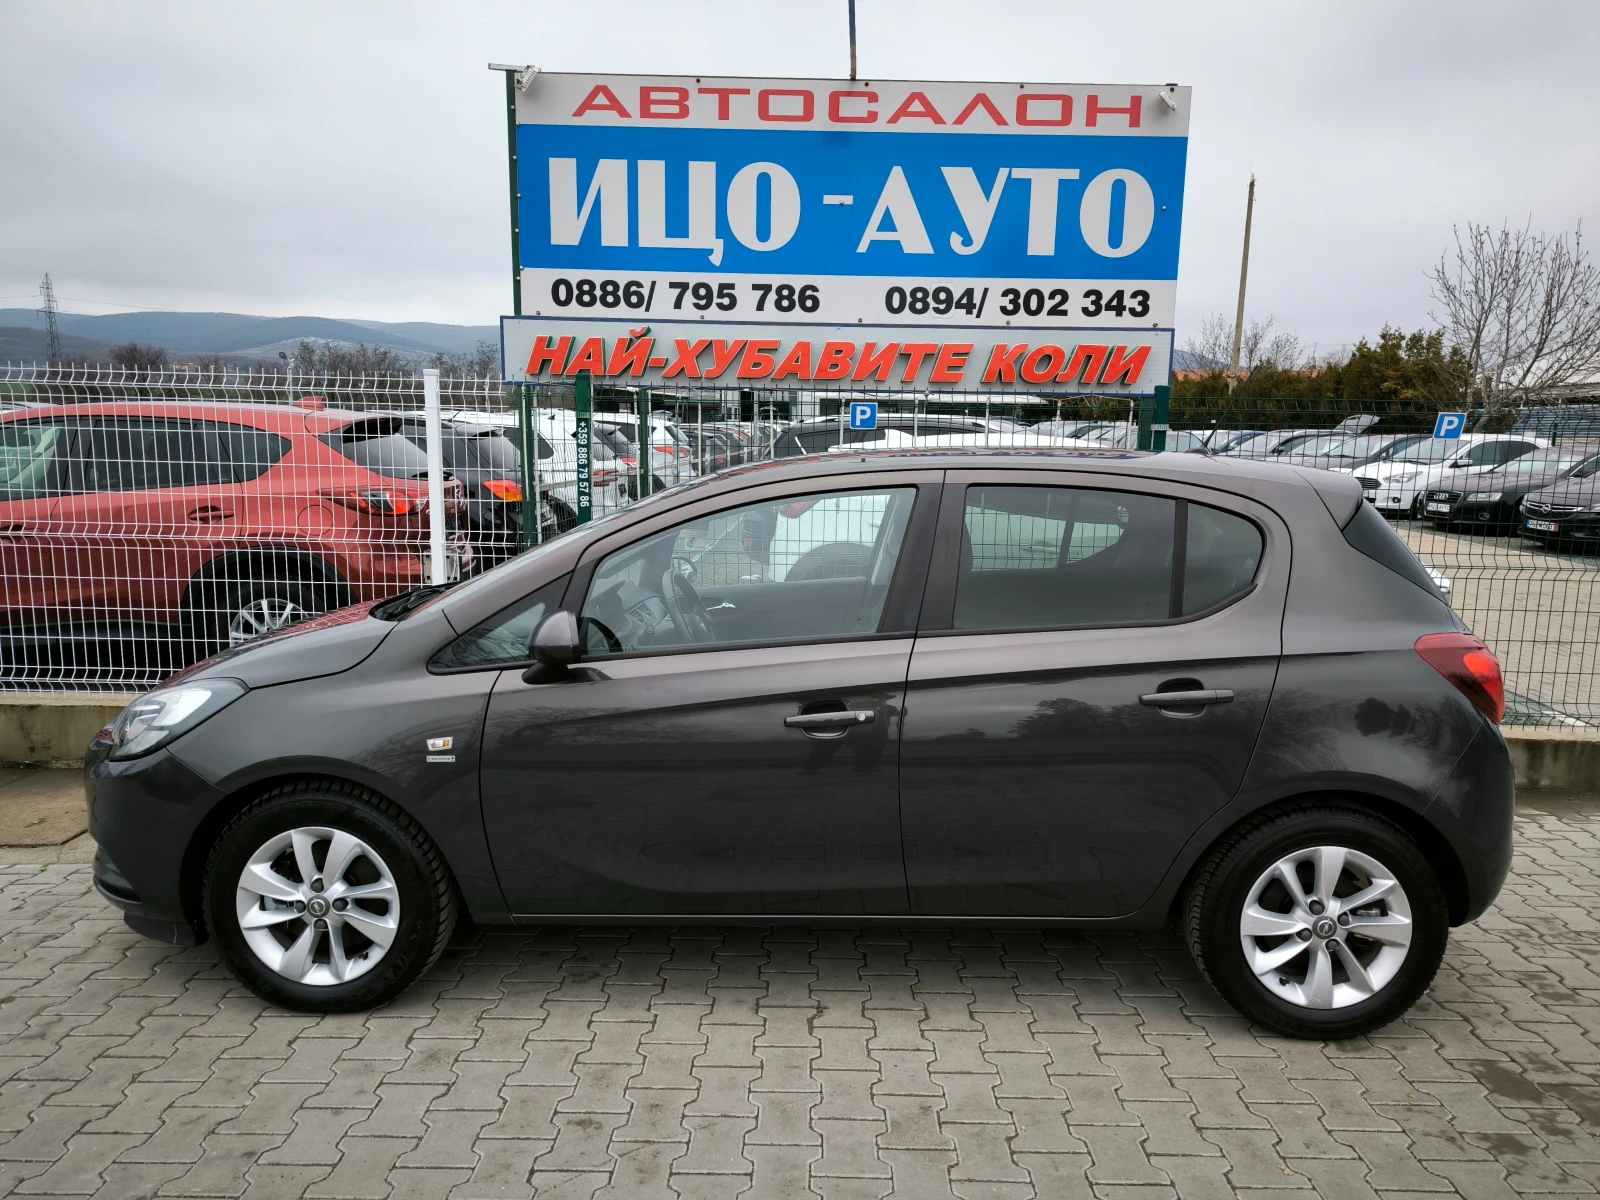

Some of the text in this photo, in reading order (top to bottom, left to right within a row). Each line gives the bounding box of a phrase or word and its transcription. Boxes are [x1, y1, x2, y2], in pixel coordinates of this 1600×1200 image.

[572, 84, 1143, 128] АВТОСАЛОН
[548, 157, 801, 267] ИЦО
[551, 278, 1151, 319] 0886/ 795 786 0894/ 302 343
[525, 327, 1152, 386] НАЙ-ХУБАВИТЕ КОЛИ
[856, 405, 872, 426] P
[1440, 416, 1459, 437] P
[577, 421, 590, 507] +359 886 79 57 86
